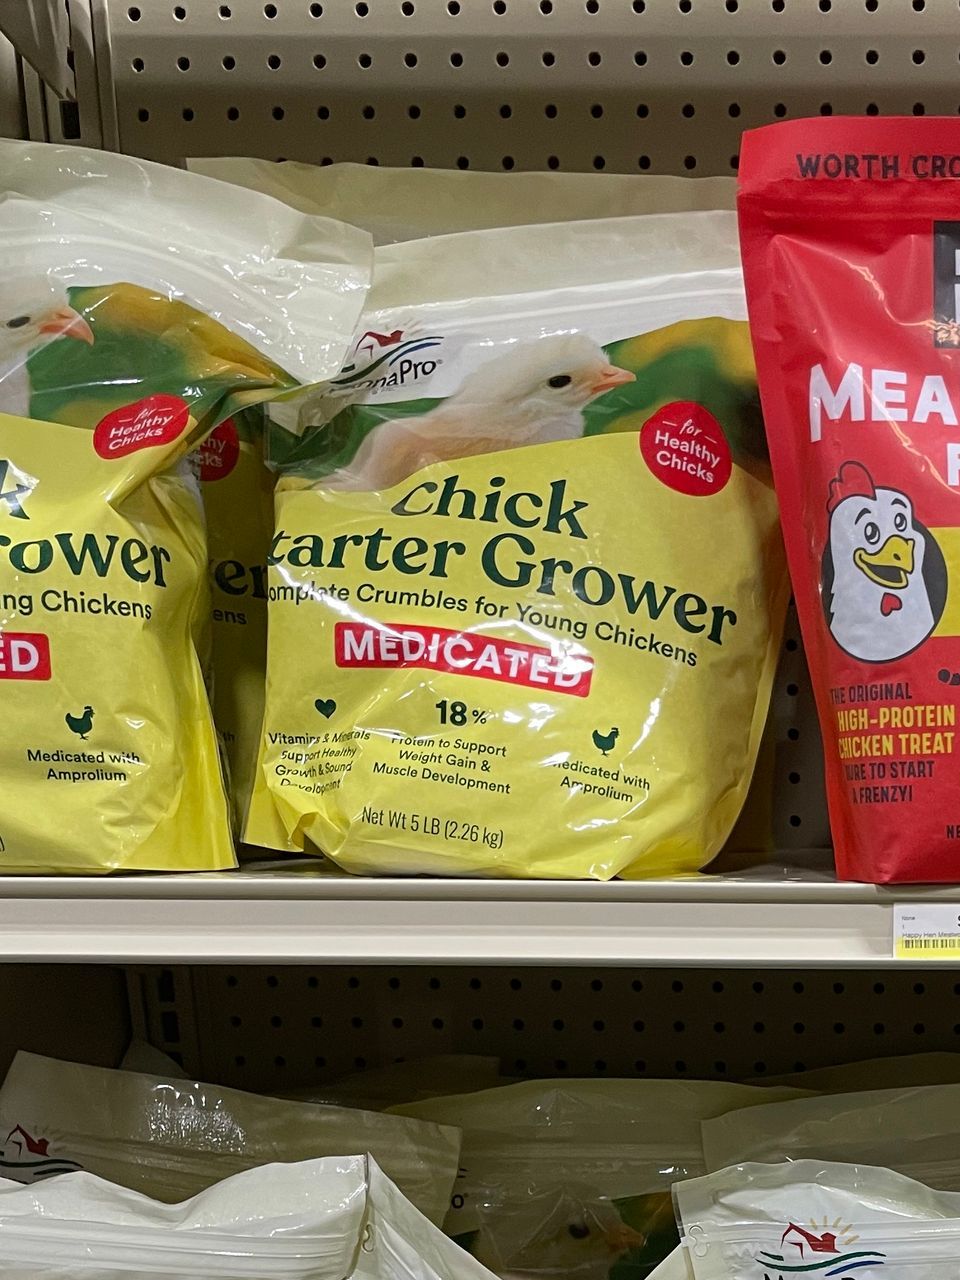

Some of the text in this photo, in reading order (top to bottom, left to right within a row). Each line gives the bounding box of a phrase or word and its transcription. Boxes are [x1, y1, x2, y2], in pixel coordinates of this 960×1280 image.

[796, 153, 899, 180] WORTH
[108, 427, 163, 450] Chicks
[109, 415, 173, 440] Healthy
[655, 430, 720, 468] Healthy
[656, 450, 714, 483] Chicks
[391, 473, 589, 540] Chick
[481, 533, 738, 646] Grower
[41, 590, 152, 620] Chickens
[356, 583, 698, 667] Crumbles for Young Chickens
[344, 629, 583, 688] MEDICATED
[848, 682, 913, 703] ORIGINAL
[838, 705, 956, 732] HIGH-PROTEIN
[27, 749, 141, 764] Medicated with
[453, 739, 507, 758] Support
[838, 732, 955, 759] CHICKEN TREAT
[399, 750, 477, 770] Weight Gain
[890, 760, 935, 779] START
[47, 768, 127, 783] Amprolium
[373, 762, 511, 795] Muscle Development
[560, 775, 633, 803] Amprolium
[623, 775, 651, 791] with
[859, 785, 913, 804] FRENZY!
[362, 807, 441, 835] Net Wt LB
